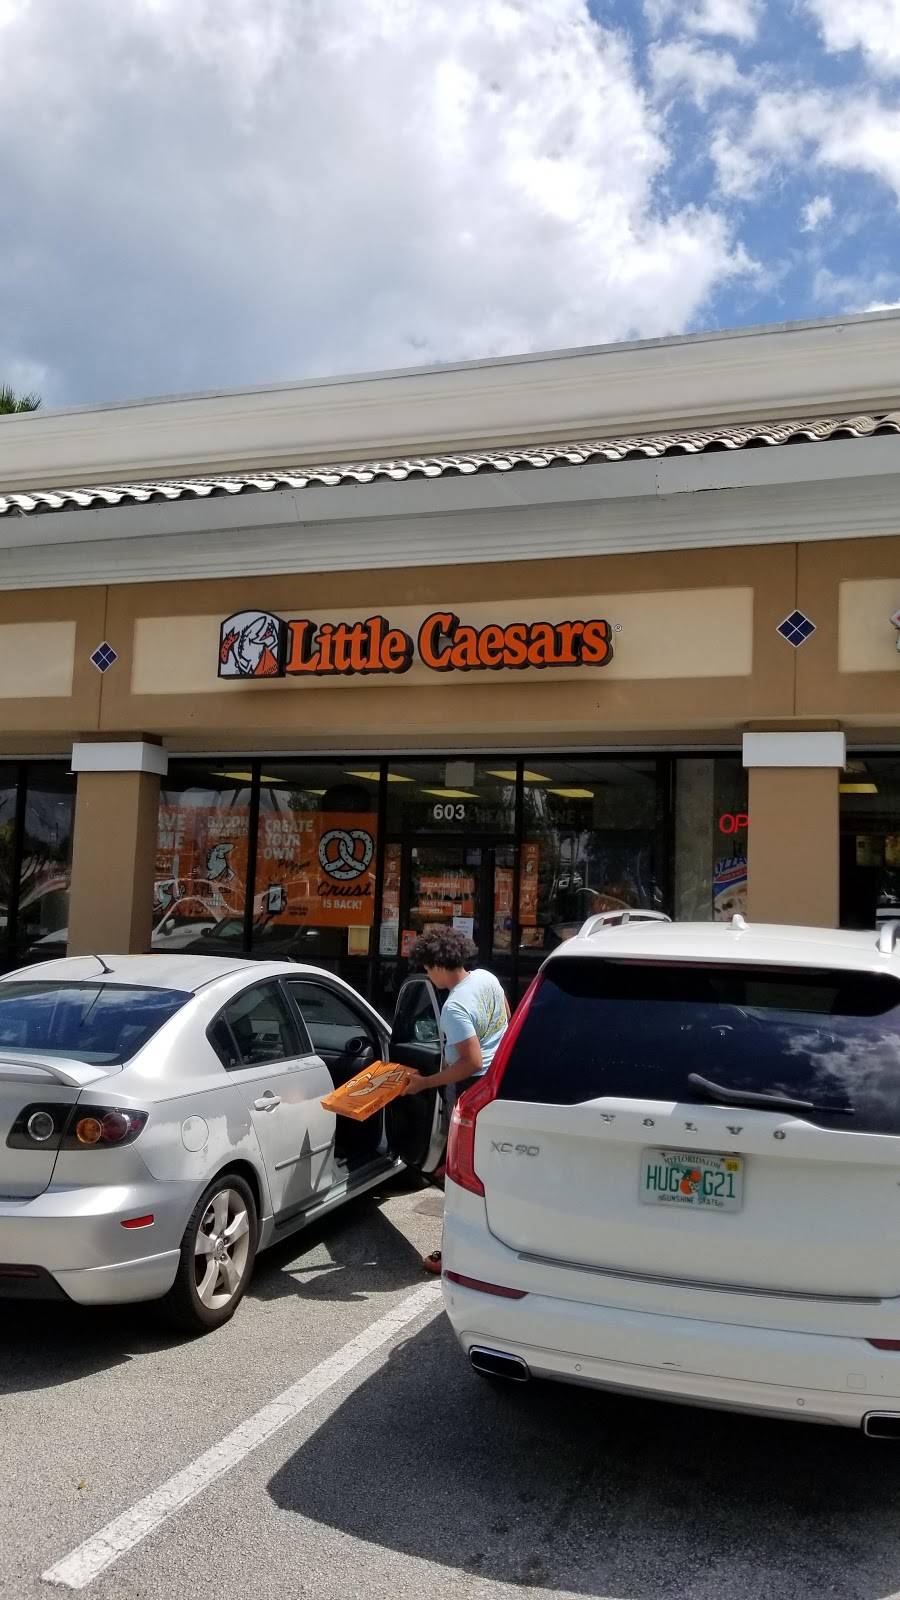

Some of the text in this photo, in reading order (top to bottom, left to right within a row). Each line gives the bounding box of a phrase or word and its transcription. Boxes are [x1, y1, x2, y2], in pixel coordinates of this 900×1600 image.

[287, 612, 612, 674] Little Caesars
[433, 804, 466, 820] 603
[264, 819, 314, 833] CREATE
[264, 833, 301, 846] YOUR
[263, 847, 294, 860] OWN
[323, 899, 362, 910] IS BACK!
[600, 1112, 787, 1140] VOLVO
[646, 1164, 736, 1199] HUG G21
